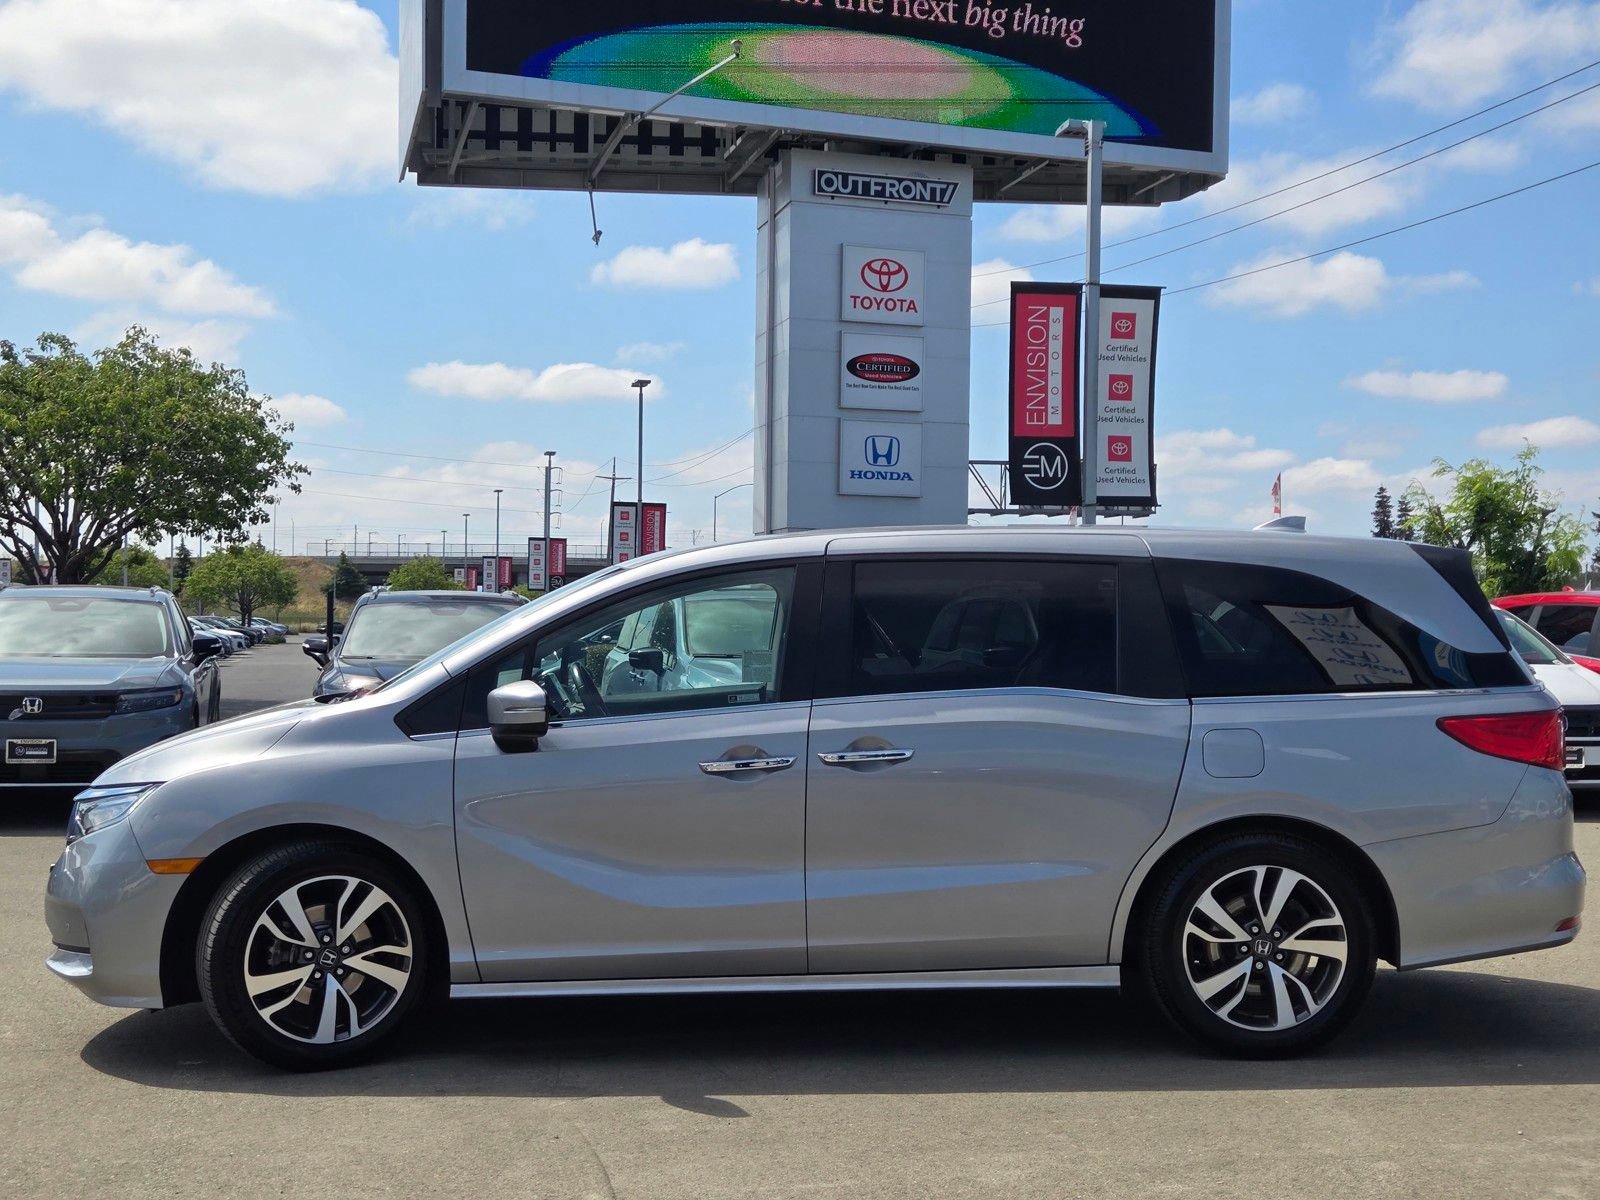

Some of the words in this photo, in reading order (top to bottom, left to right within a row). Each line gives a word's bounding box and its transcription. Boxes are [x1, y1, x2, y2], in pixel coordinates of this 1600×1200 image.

[892, 0, 958, 24] next
[964, 0, 1008, 39] big
[1013, 2, 1086, 48] thing
[850, 295, 918, 314] TOYOTA
[1106, 344, 1138, 353] Certified
[1117, 354, 1147, 363] Vehicles
[856, 362, 911, 373] CERTIFIED
[1026, 305, 1048, 425] ENVISION
[1050, 317, 1061, 415] MOTORS
[1104, 406, 1136, 414] Certified
[1115, 416, 1145, 424] Vehicles
[849, 470, 914, 481] HONDA
[1104, 467, 1136, 475] Certified
[1115, 477, 1146, 485] Vehicles
[646, 510, 655, 551] ENVISION
